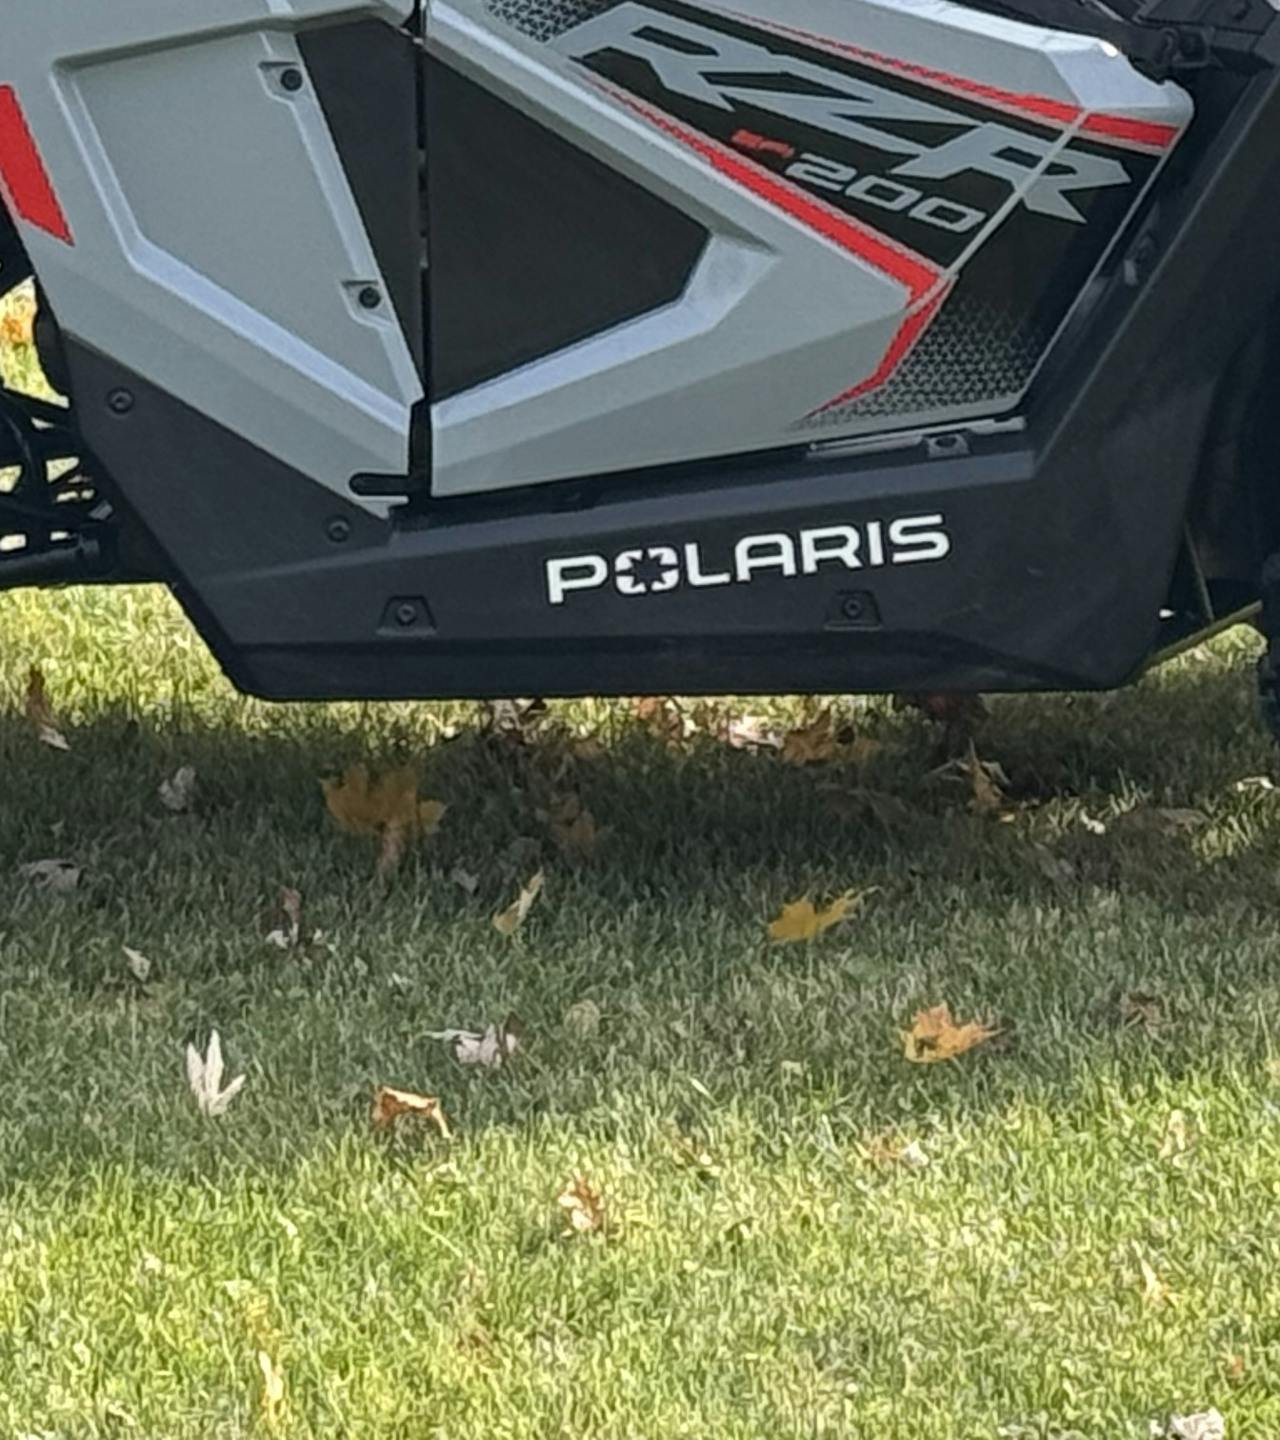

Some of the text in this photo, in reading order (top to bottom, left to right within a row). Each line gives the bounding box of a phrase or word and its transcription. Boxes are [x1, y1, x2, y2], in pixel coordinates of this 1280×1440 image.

[546, 1, 1132, 224] RZR
[785, 151, 987, 233] 200
[546, 514, 951, 604] POLARIS
